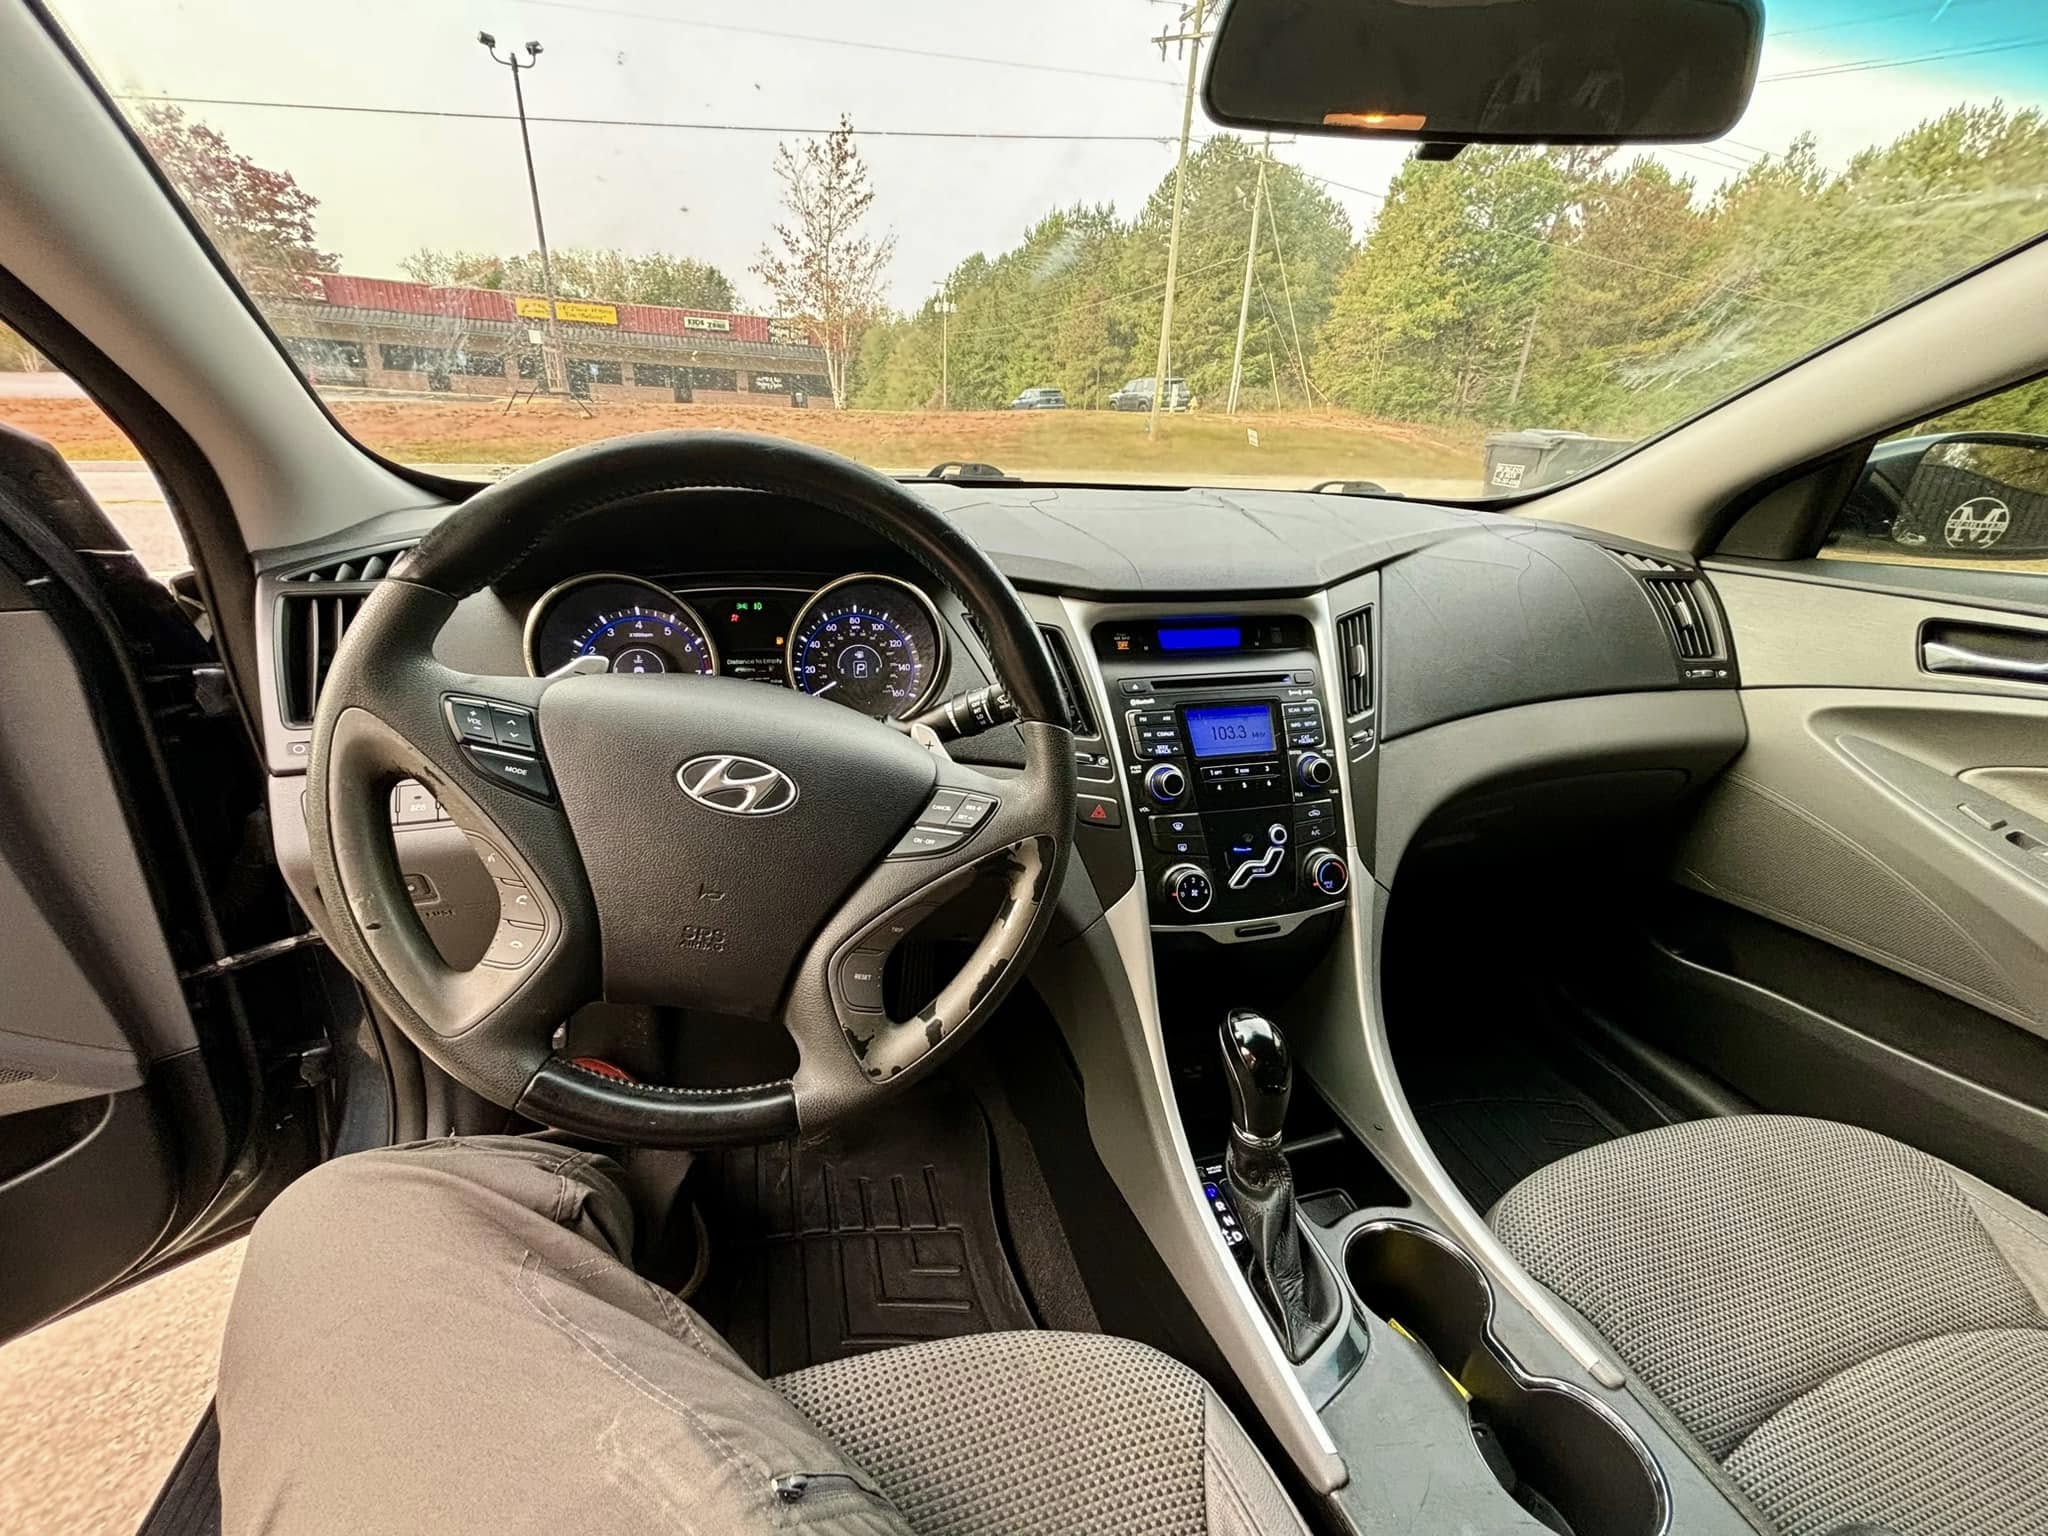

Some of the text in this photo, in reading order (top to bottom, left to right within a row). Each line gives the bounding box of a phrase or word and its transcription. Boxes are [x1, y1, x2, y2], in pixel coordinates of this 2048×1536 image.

[635, 620, 643, 629] 4
[849, 616, 860, 625] 80
[664, 627, 672, 636] 5
[825, 623, 838, 632] 60
[871, 623, 885, 631] 100
[607, 627, 615, 637] 3
[684, 643, 692, 653] 6
[809, 640, 821, 649] 40
[889, 640, 902, 648] 120
[588, 646, 596, 655] 2
[805, 665, 816, 674] 20
[856, 663, 866, 675] P
[898, 664, 911, 672] 140
[891, 689, 905, 697] 160
[467, 716, 482, 726] VOL
[1211, 725, 1247, 741] 103.3
[505, 766, 528, 776] MODE
[1215, 1201, 1226, 1212] R
[1222, 1215, 1235, 1227] N
[1231, 1231, 1243, 1242] D
